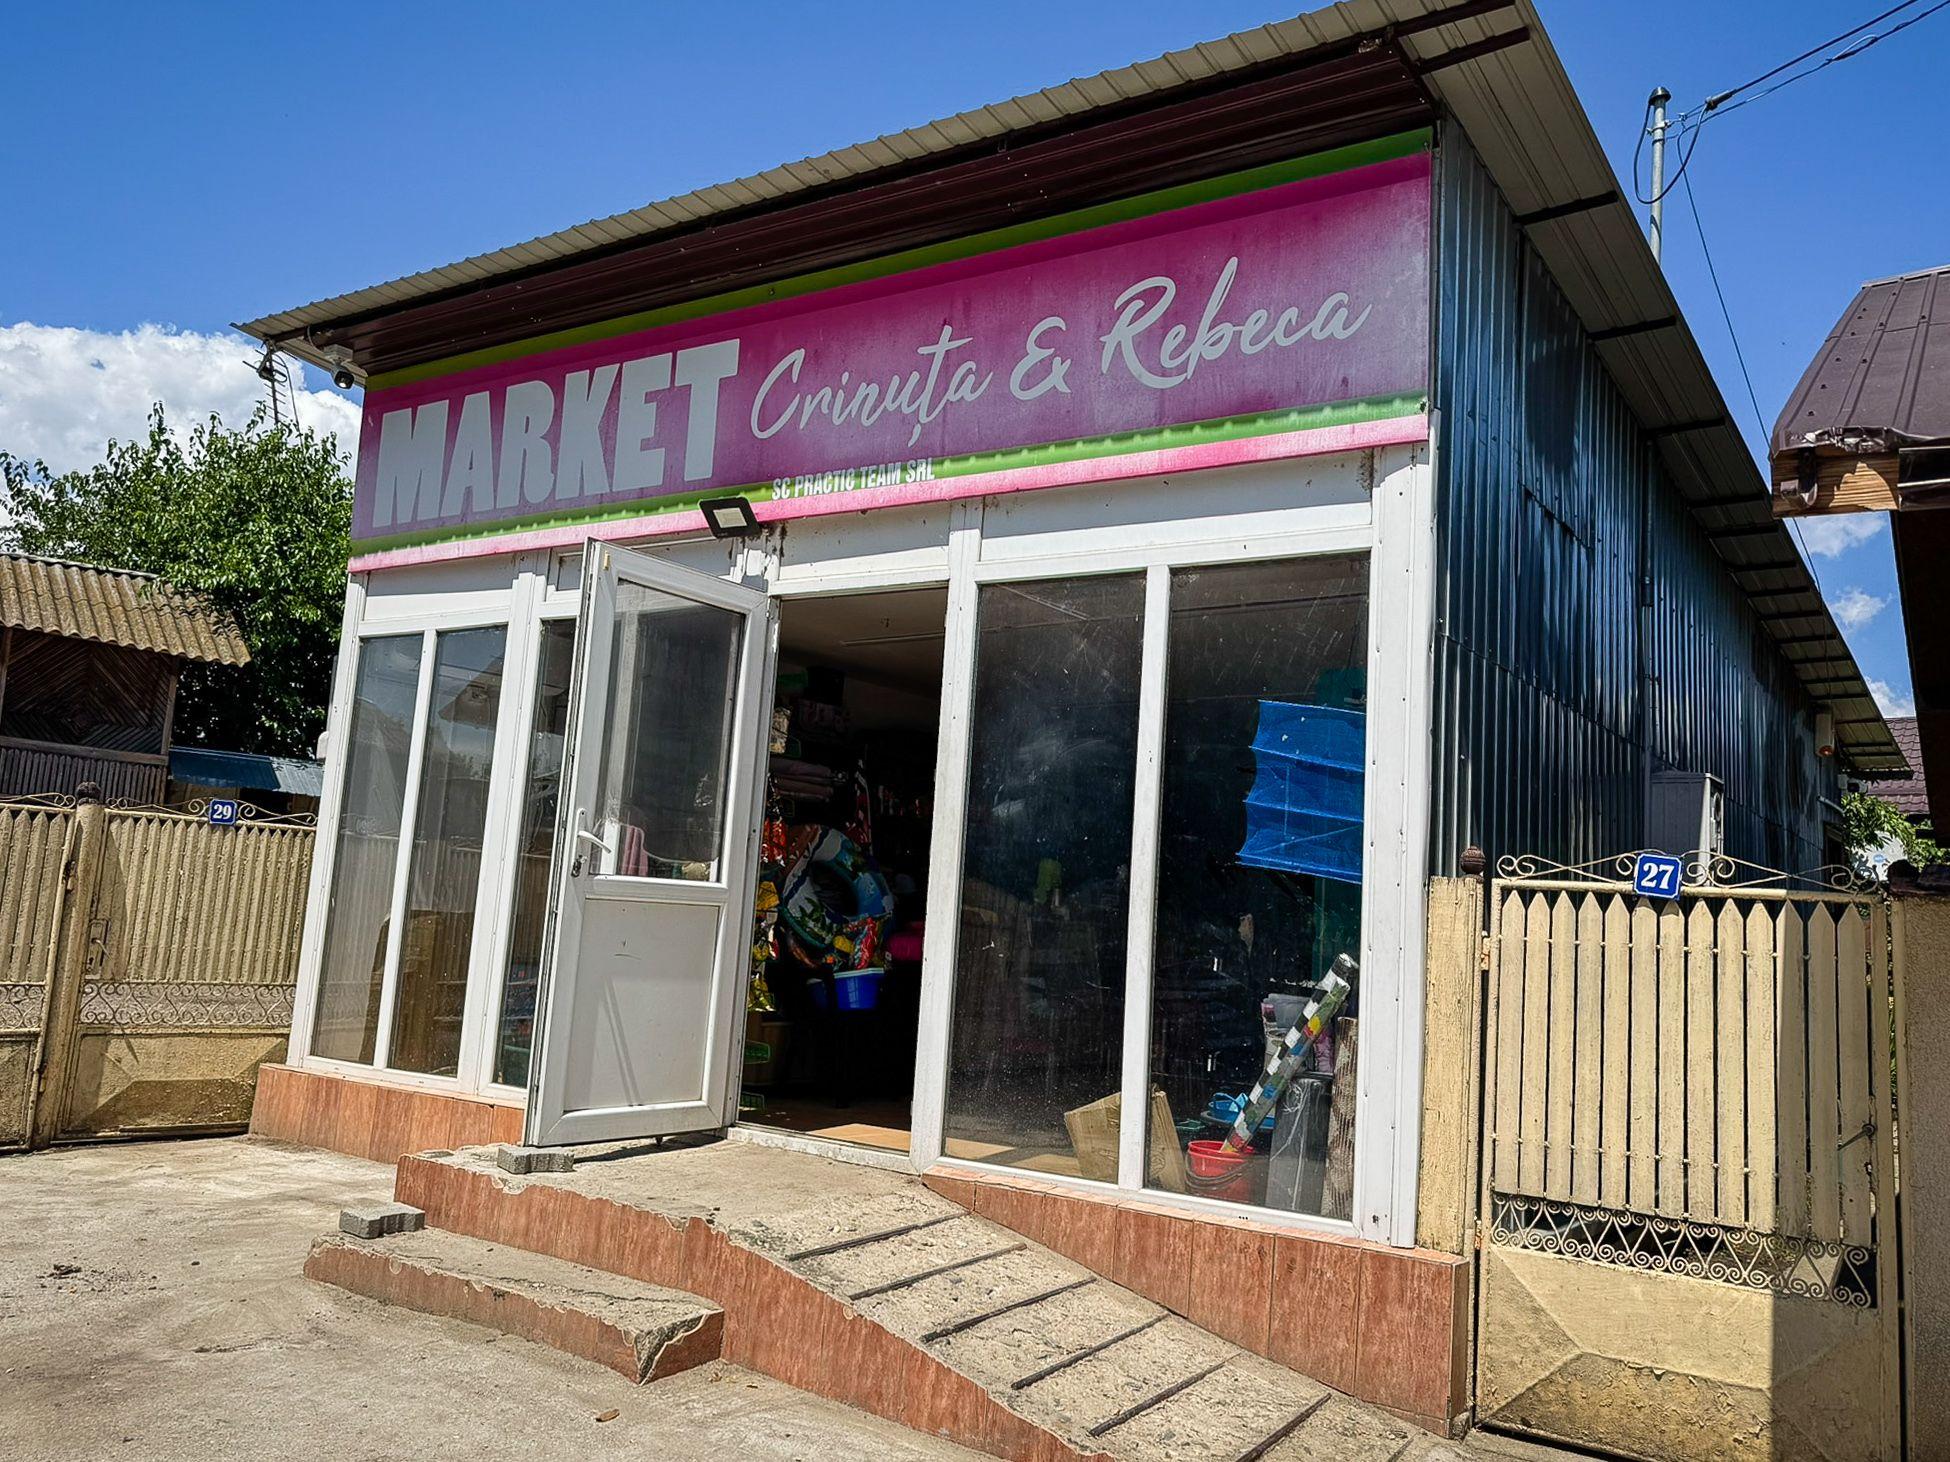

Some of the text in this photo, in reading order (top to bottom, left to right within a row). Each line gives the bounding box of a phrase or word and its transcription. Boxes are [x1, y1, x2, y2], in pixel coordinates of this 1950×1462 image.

[373, 257, 1372, 528] MARKET Crinuța & Rebeca
[772, 457, 936, 500] SC PRACTIC TEAM SRL
[213, 804, 232, 820] 29
[1641, 862, 1675, 890] 27
